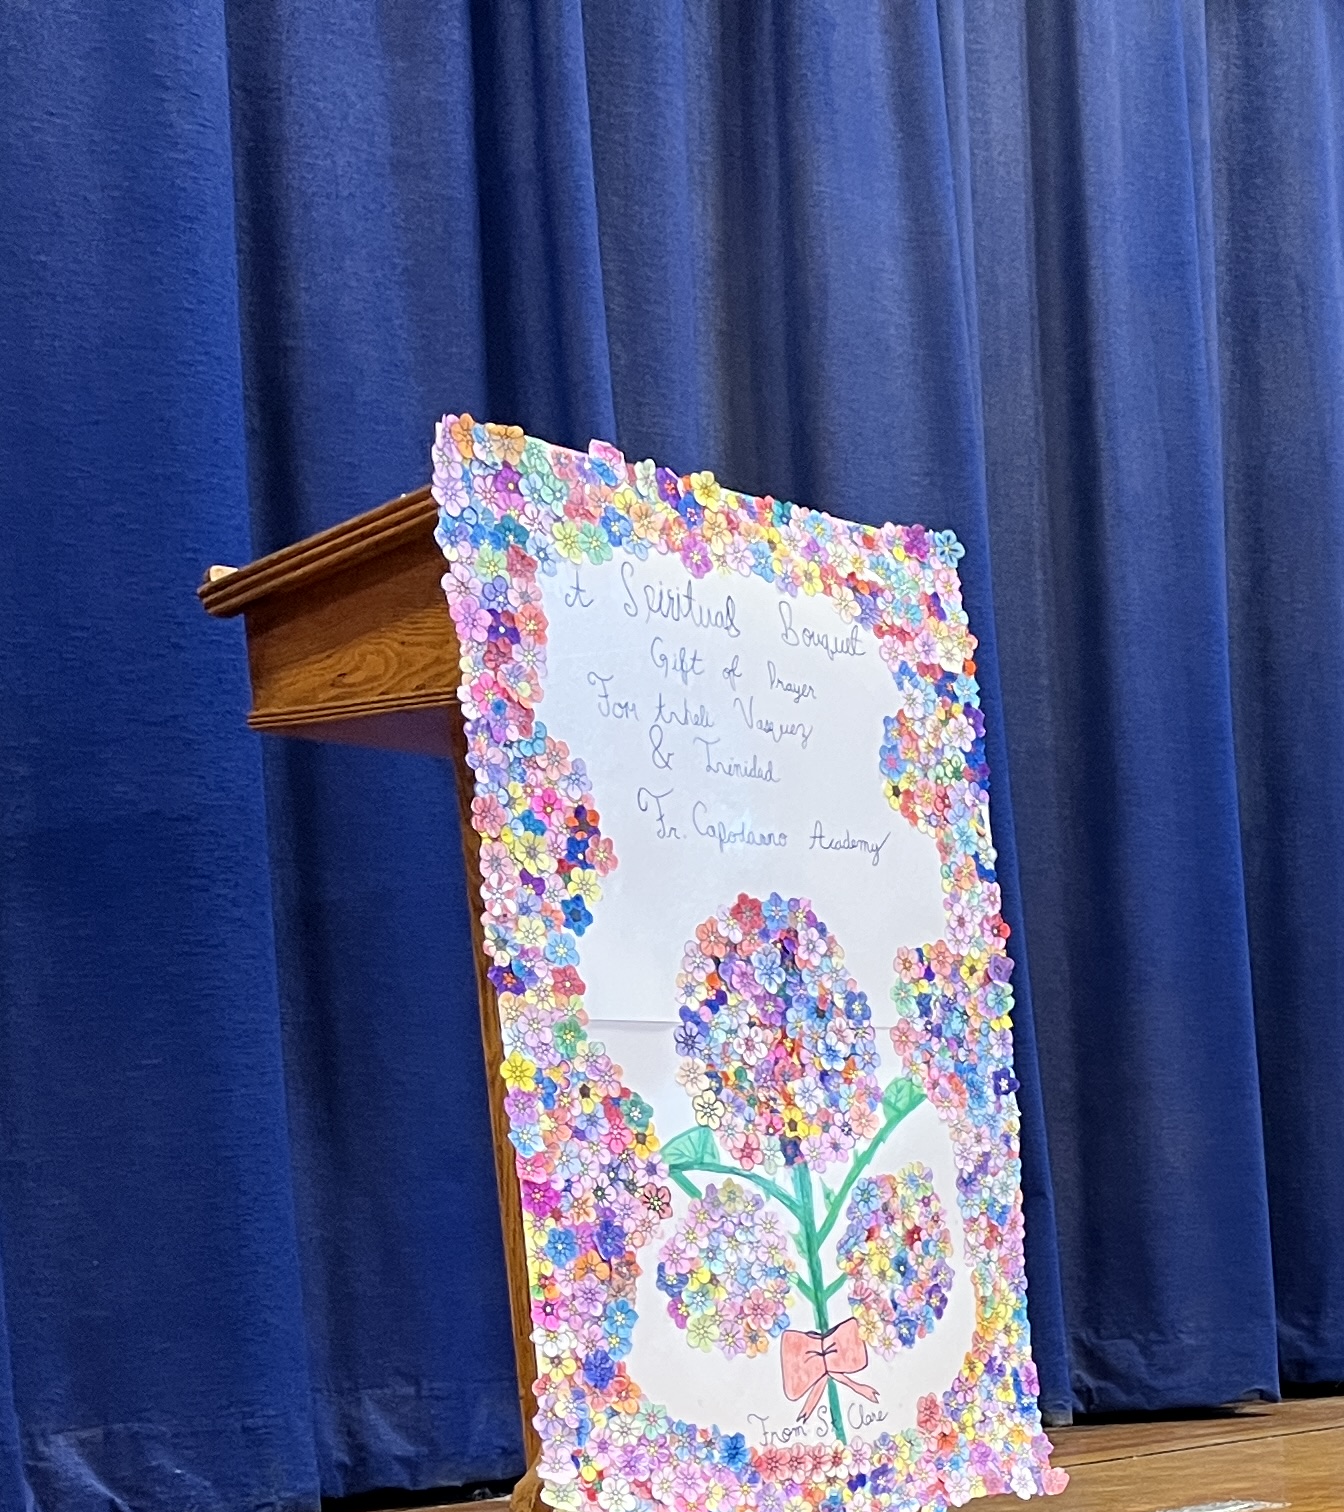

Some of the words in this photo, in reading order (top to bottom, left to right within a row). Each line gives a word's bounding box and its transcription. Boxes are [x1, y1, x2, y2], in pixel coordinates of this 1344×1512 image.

[621, 561, 741, 638] Spiritual
[778, 600, 867, 661] Bouquet
[587, 671, 640, 722] For
[650, 637, 705, 685] Gift
[722, 655, 743, 691] of
[767, 660, 817, 703] Prayer
[649, 724, 675, 771] &
[693, 736, 781, 783] Trinidad
[809, 820, 892, 867] Academy
[747, 1412, 808, 1447] From
[847, 1402, 889, 1430] Clare
